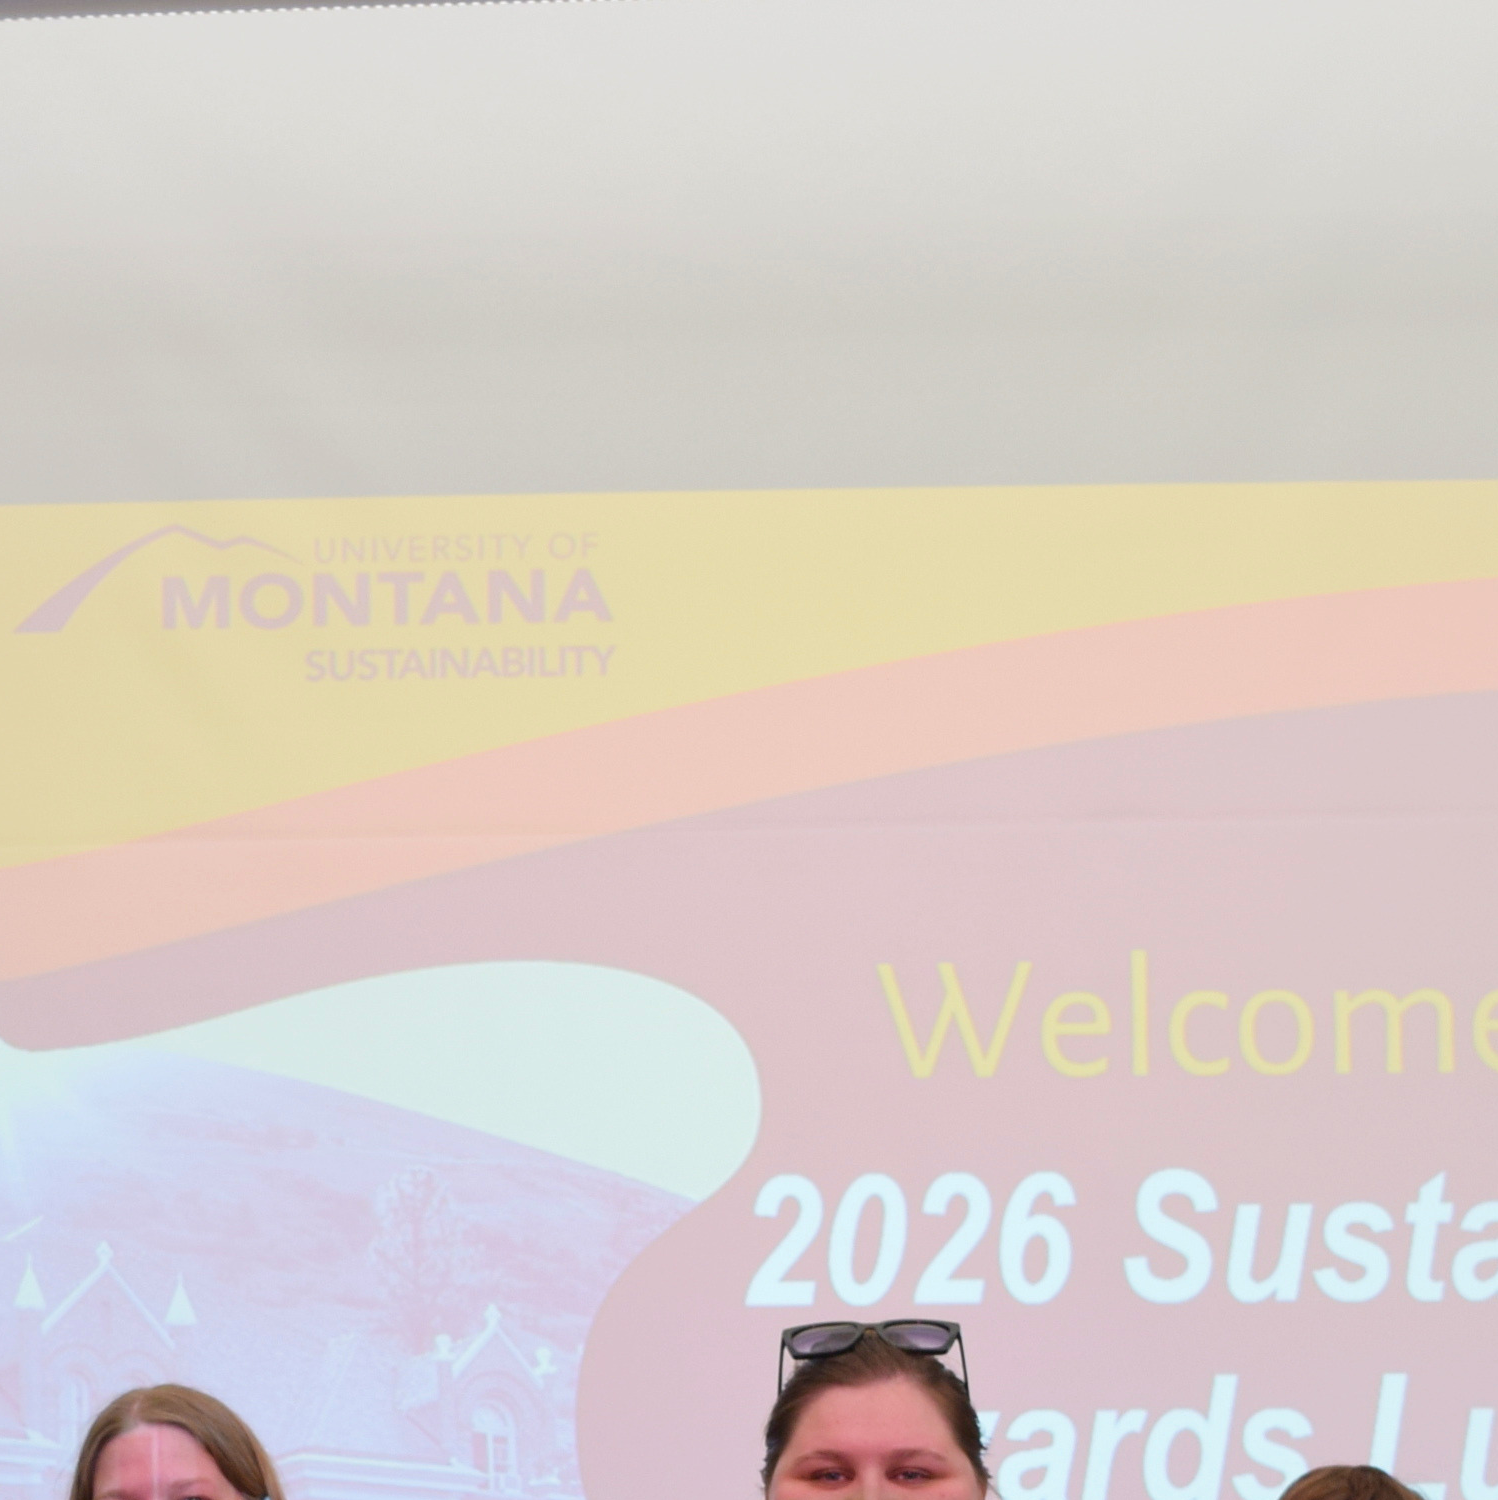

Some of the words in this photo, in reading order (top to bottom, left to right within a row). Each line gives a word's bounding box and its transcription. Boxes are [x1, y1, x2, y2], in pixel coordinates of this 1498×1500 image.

[314, 534, 533, 564] UNIVERSITY
[548, 532, 599, 560] OF
[161, 568, 614, 630] MONTANA
[305, 645, 616, 682] SUSTAINABILITY
[745, 1171, 1077, 1306] 2026
